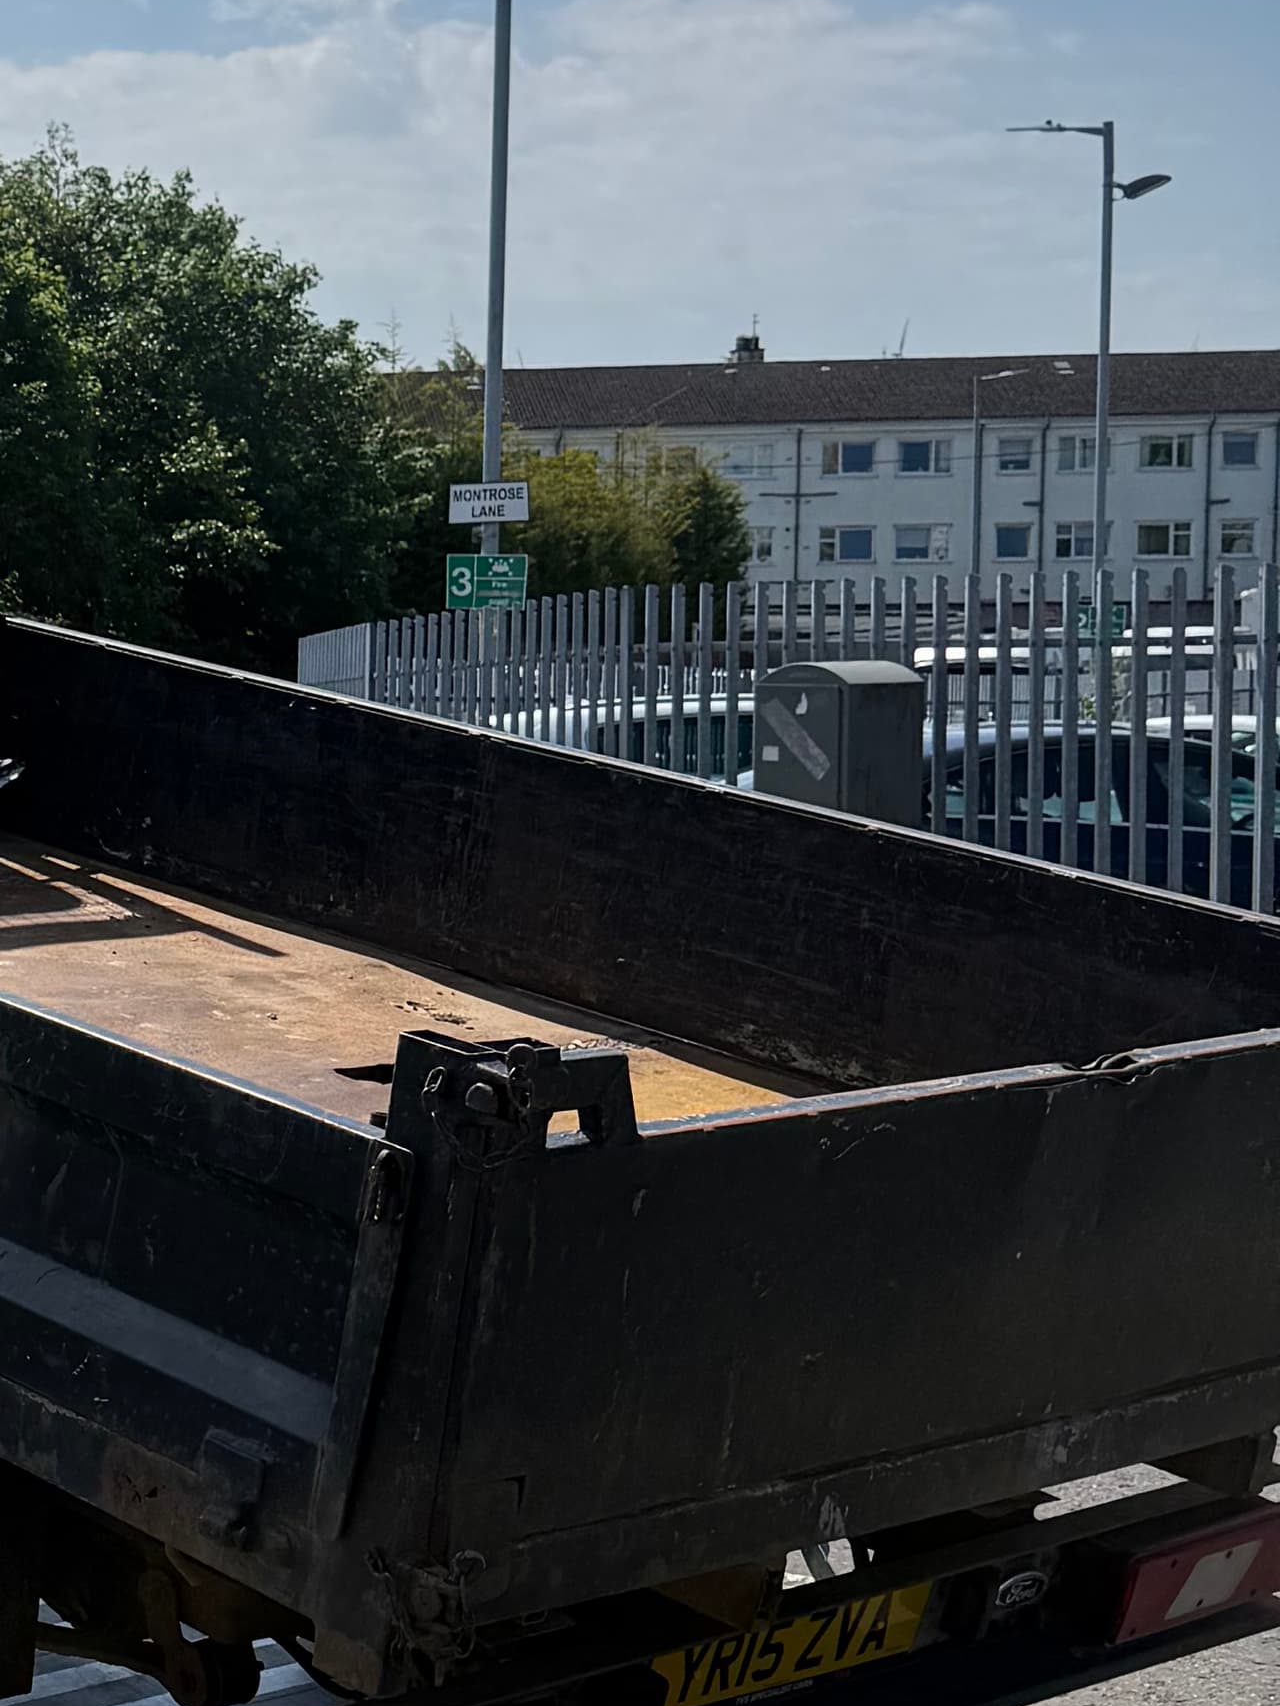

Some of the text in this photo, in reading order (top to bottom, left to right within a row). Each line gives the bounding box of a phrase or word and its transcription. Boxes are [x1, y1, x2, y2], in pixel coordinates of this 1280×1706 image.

[453, 487, 524, 502] MONTROSE
[471, 504, 506, 518] LANE
[450, 567, 472, 596] 3
[1006, 1580, 1040, 1604] Ford
[677, 1593, 889, 1704] YR15 ZVA
